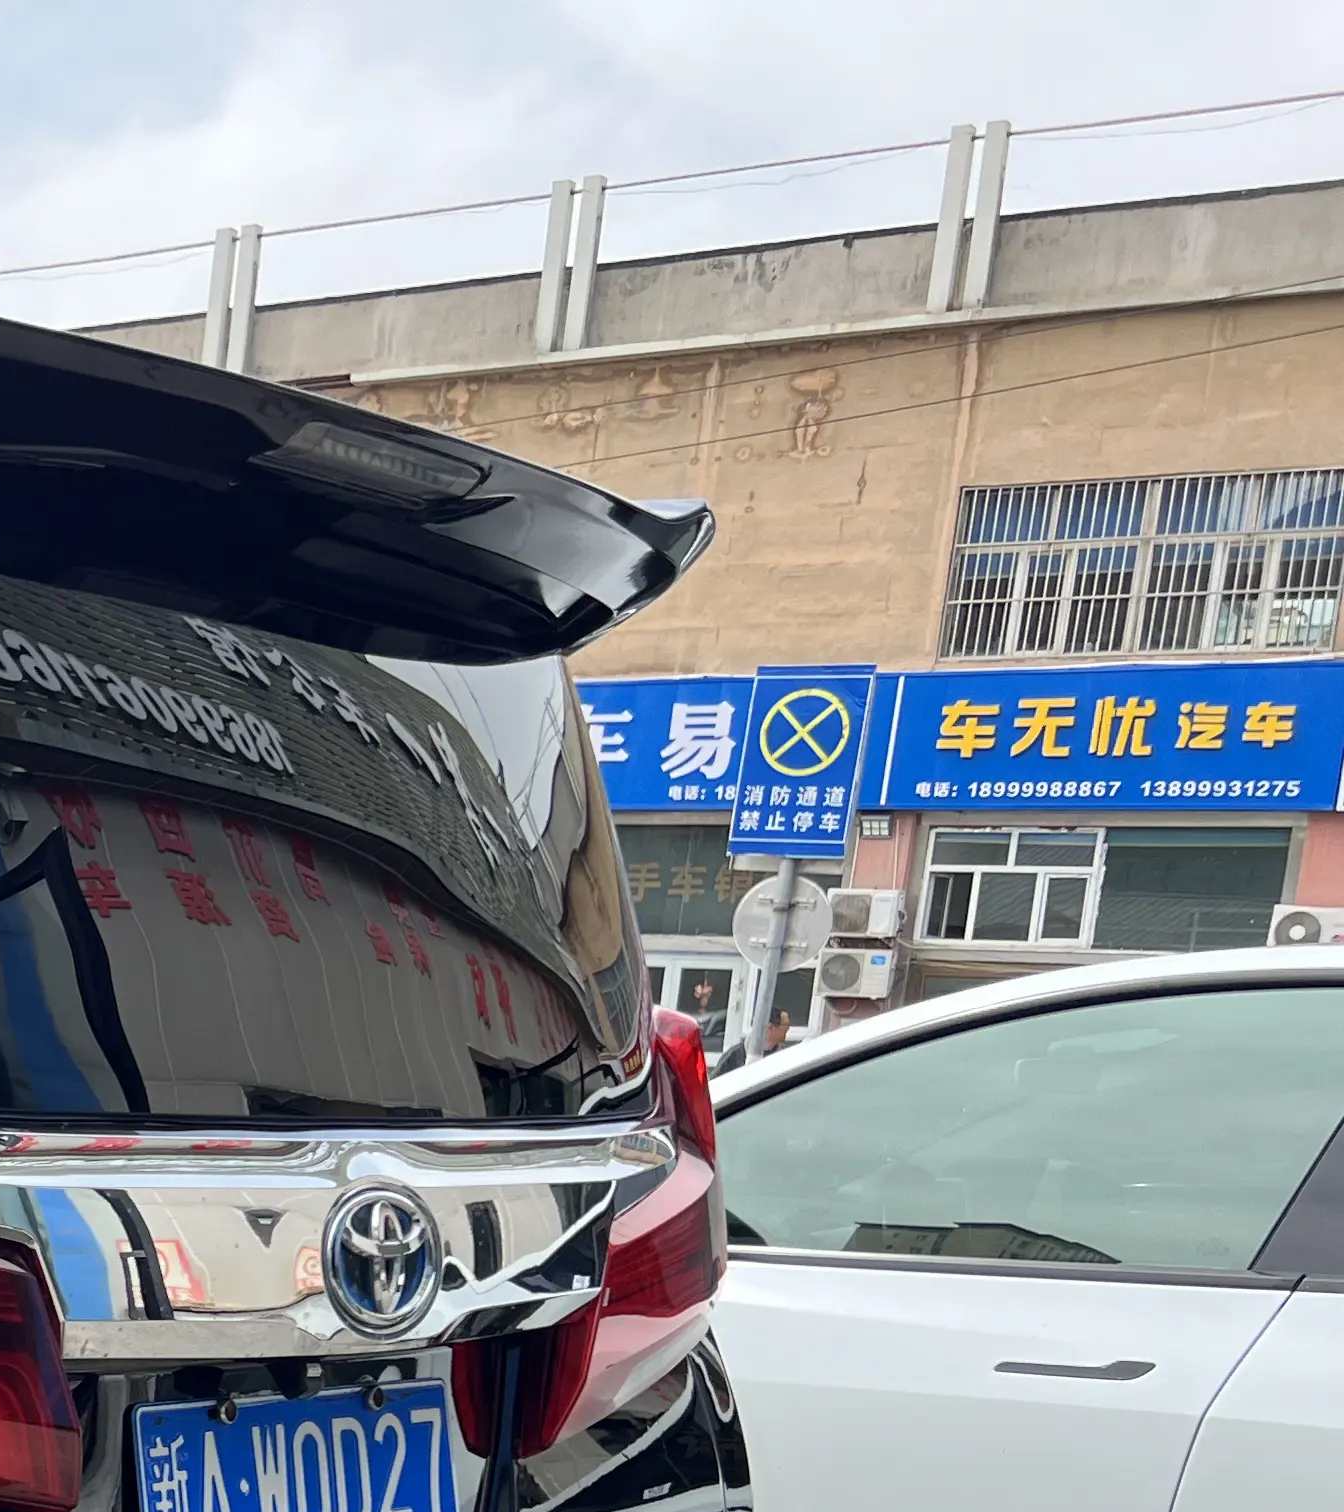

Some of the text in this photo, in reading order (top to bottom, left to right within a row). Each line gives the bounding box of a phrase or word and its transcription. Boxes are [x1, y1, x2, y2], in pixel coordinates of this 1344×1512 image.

[743, 785, 847, 807] 消防通道
[966, 780, 1123, 798] 18999988867
[1138, 779, 1302, 798] 13899931275
[739, 811, 841, 834] 禁止停车
